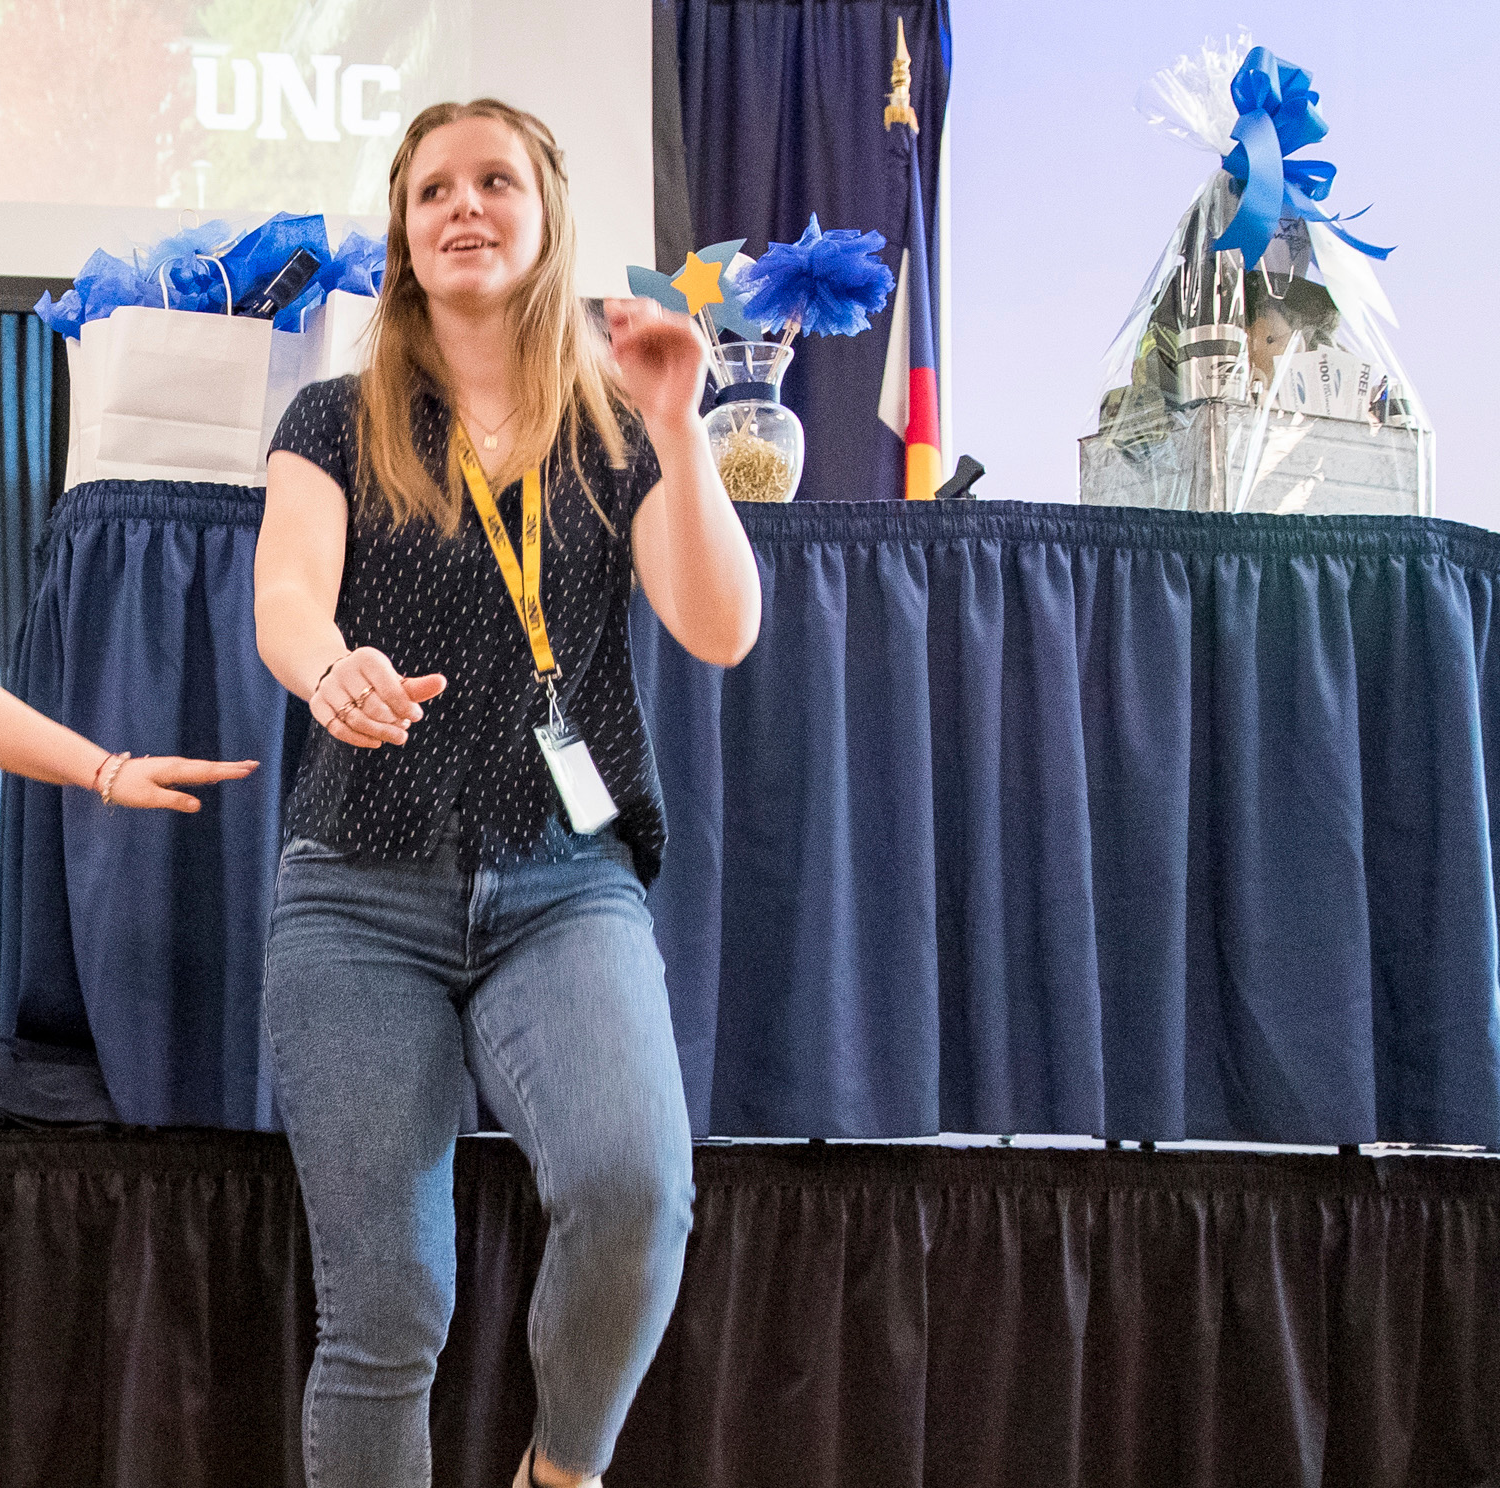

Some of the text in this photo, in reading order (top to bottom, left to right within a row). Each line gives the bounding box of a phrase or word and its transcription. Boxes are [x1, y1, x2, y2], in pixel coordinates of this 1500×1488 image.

[192, 52, 401, 142] UNC
[1319, 353, 1331, 382] $100
[1358, 363, 1370, 396] FREE
[525, 513, 538, 547] UNC
[527, 594, 541, 631] UNC
